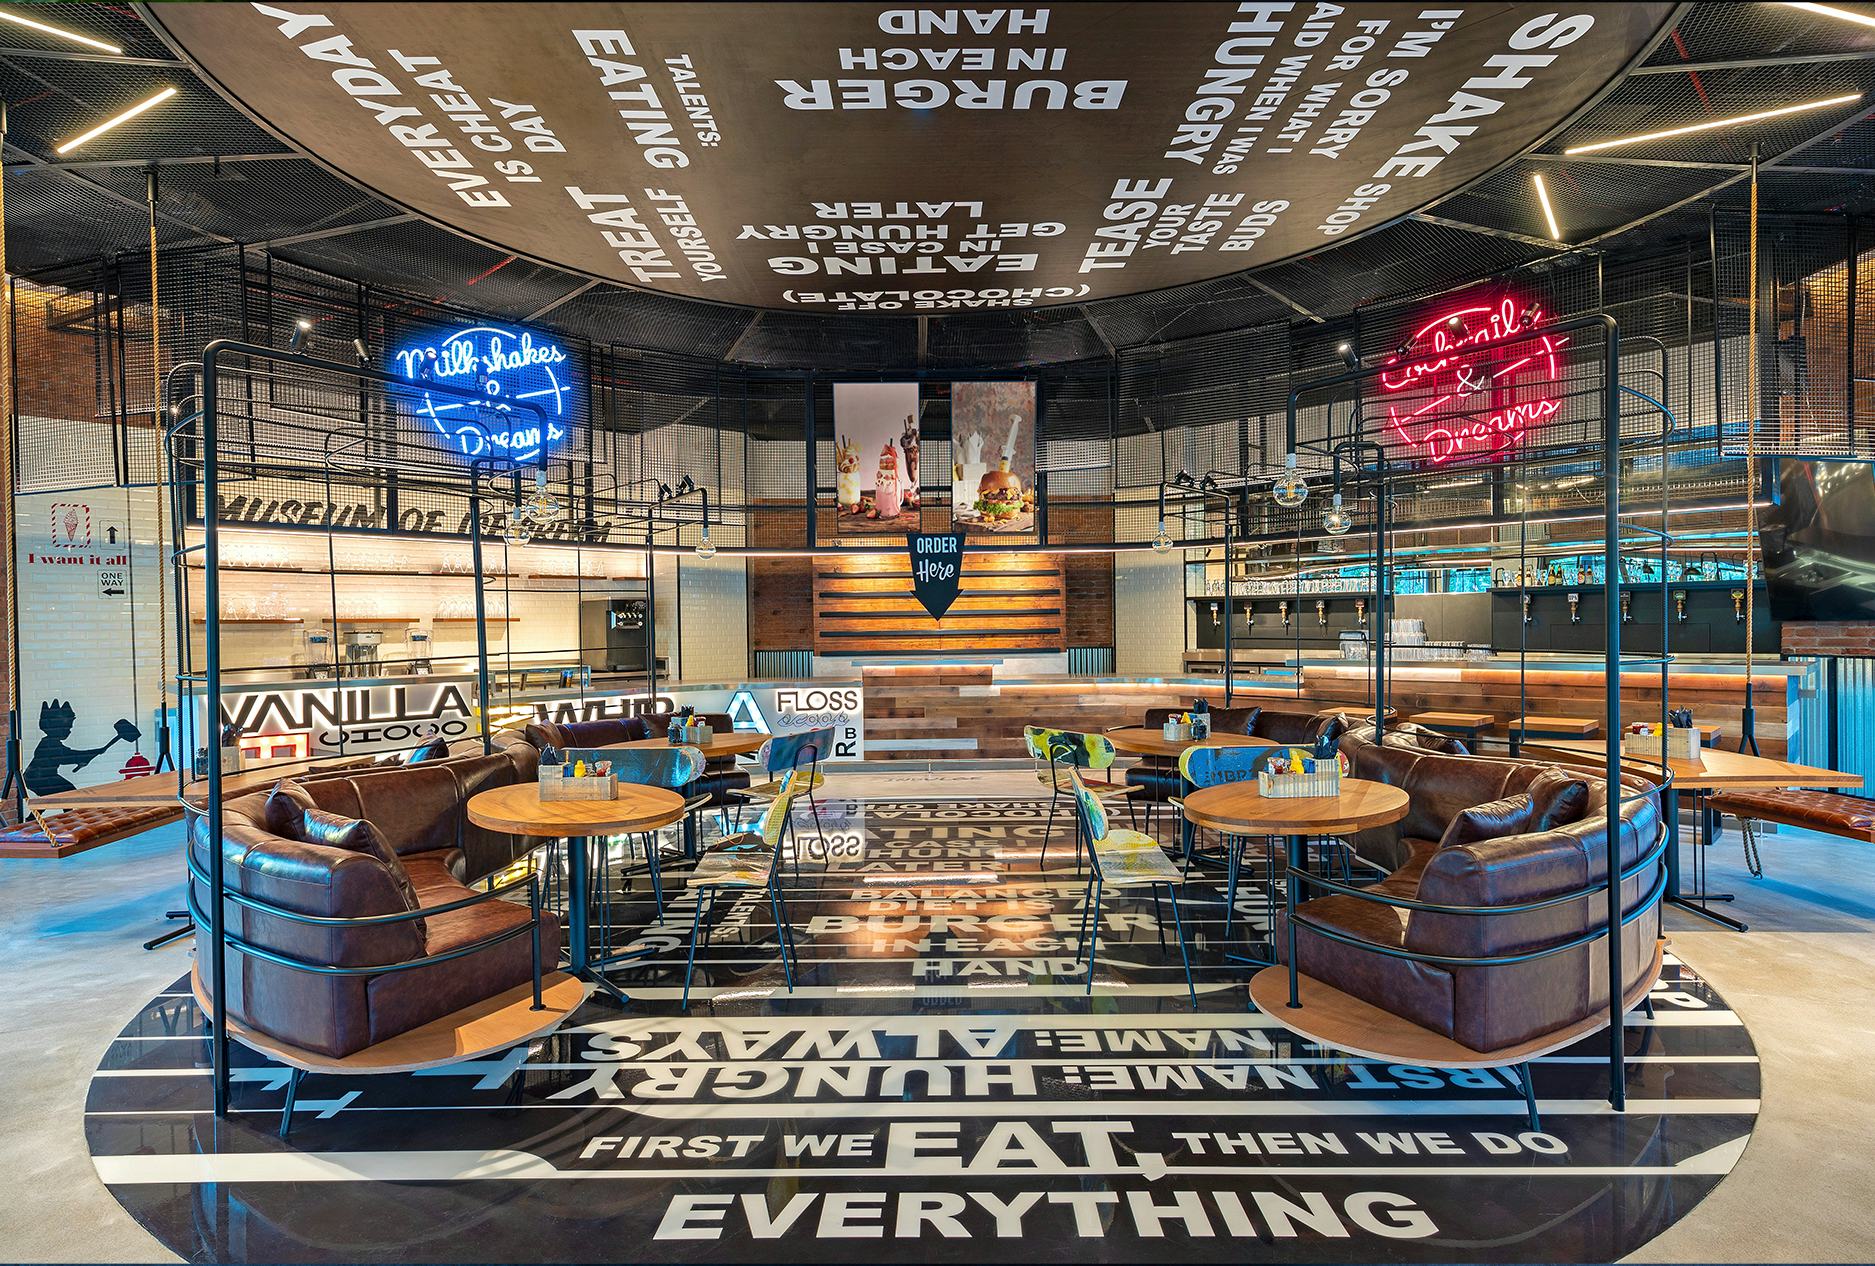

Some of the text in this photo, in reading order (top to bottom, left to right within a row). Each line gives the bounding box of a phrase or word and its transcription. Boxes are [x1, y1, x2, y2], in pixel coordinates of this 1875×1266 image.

[878, 8, 1051, 35] HAND
[839, 48, 1067, 71] IN EACH
[1325, 20, 1390, 71] FOR
[571, 29, 689, 170] EATING
[774, 79, 1129, 111] BURGER
[1164, 2, 1295, 165] HUNGRY
[1244, 54, 1314, 120] WHEN
[1309, 9, 1465, 160] I'M SORRY
[249, 2, 512, 208] EVERYDAY
[387, 49, 542, 183] IS CHEAT
[664, 54, 722, 148] TALENTS:
[1276, 82, 1344, 143] WHAT
[487, 97, 567, 153] DAY
[1240, 126, 1263, 134] I
[1317, 13, 1595, 235] SHAKE SHOP
[1212, 136, 1258, 175] WAS
[811, 201, 984, 219] LATER
[1079, 178, 1174, 273] TEASE
[1142, 203, 1196, 250] YOUR
[1170, 192, 1246, 256] TASTE
[1219, 200, 1291, 252] BUDS
[564, 186, 683, 283] TREAT
[644, 188, 728, 283] YOURSELF
[736, 222, 1067, 241] GET HUNGRY
[808, 240, 1002, 254] IN CASE I
[767, 253, 1039, 275] EATING
[783, 283, 1090, 304] (CHOCOLATE)
[837, 297, 1034, 310] SHAKE OFF
[1456, 364, 1485, 397] &
[1424, 397, 1561, 462] Dreams
[216, 494, 387, 528] MUSEUM
[399, 508, 446, 532] OF
[28, 553, 127, 565] I want it all
[916, 537, 957, 554] ORDER
[101, 572, 123, 580] ONE
[916, 558, 955, 583] Here
[220, 685, 472, 733] VANILLA
[777, 690, 858, 712] FLOSS
[884, 840, 1000, 848] CASE
[850, 888, 1122, 900] BALANCED
[869, 899, 991, 911] DIET
[1006, 899, 1055, 910] IS
[806, 914, 1167, 933] BURGER
[871, 937, 1105, 952] IN EACH
[912, 959, 1090, 977] HAND
[581, 1028, 1020, 1062] ALWAYS
[1036, 1029, 1275, 1052] NAME:
[546, 1063, 1037, 1100] HUNGRY
[1065, 1065, 1320, 1090] NAME:
[578, 1121, 1568, 1182] FIRST WE EAT, THEN WE DO
[652, 1191, 1439, 1241] EVERYTHING
